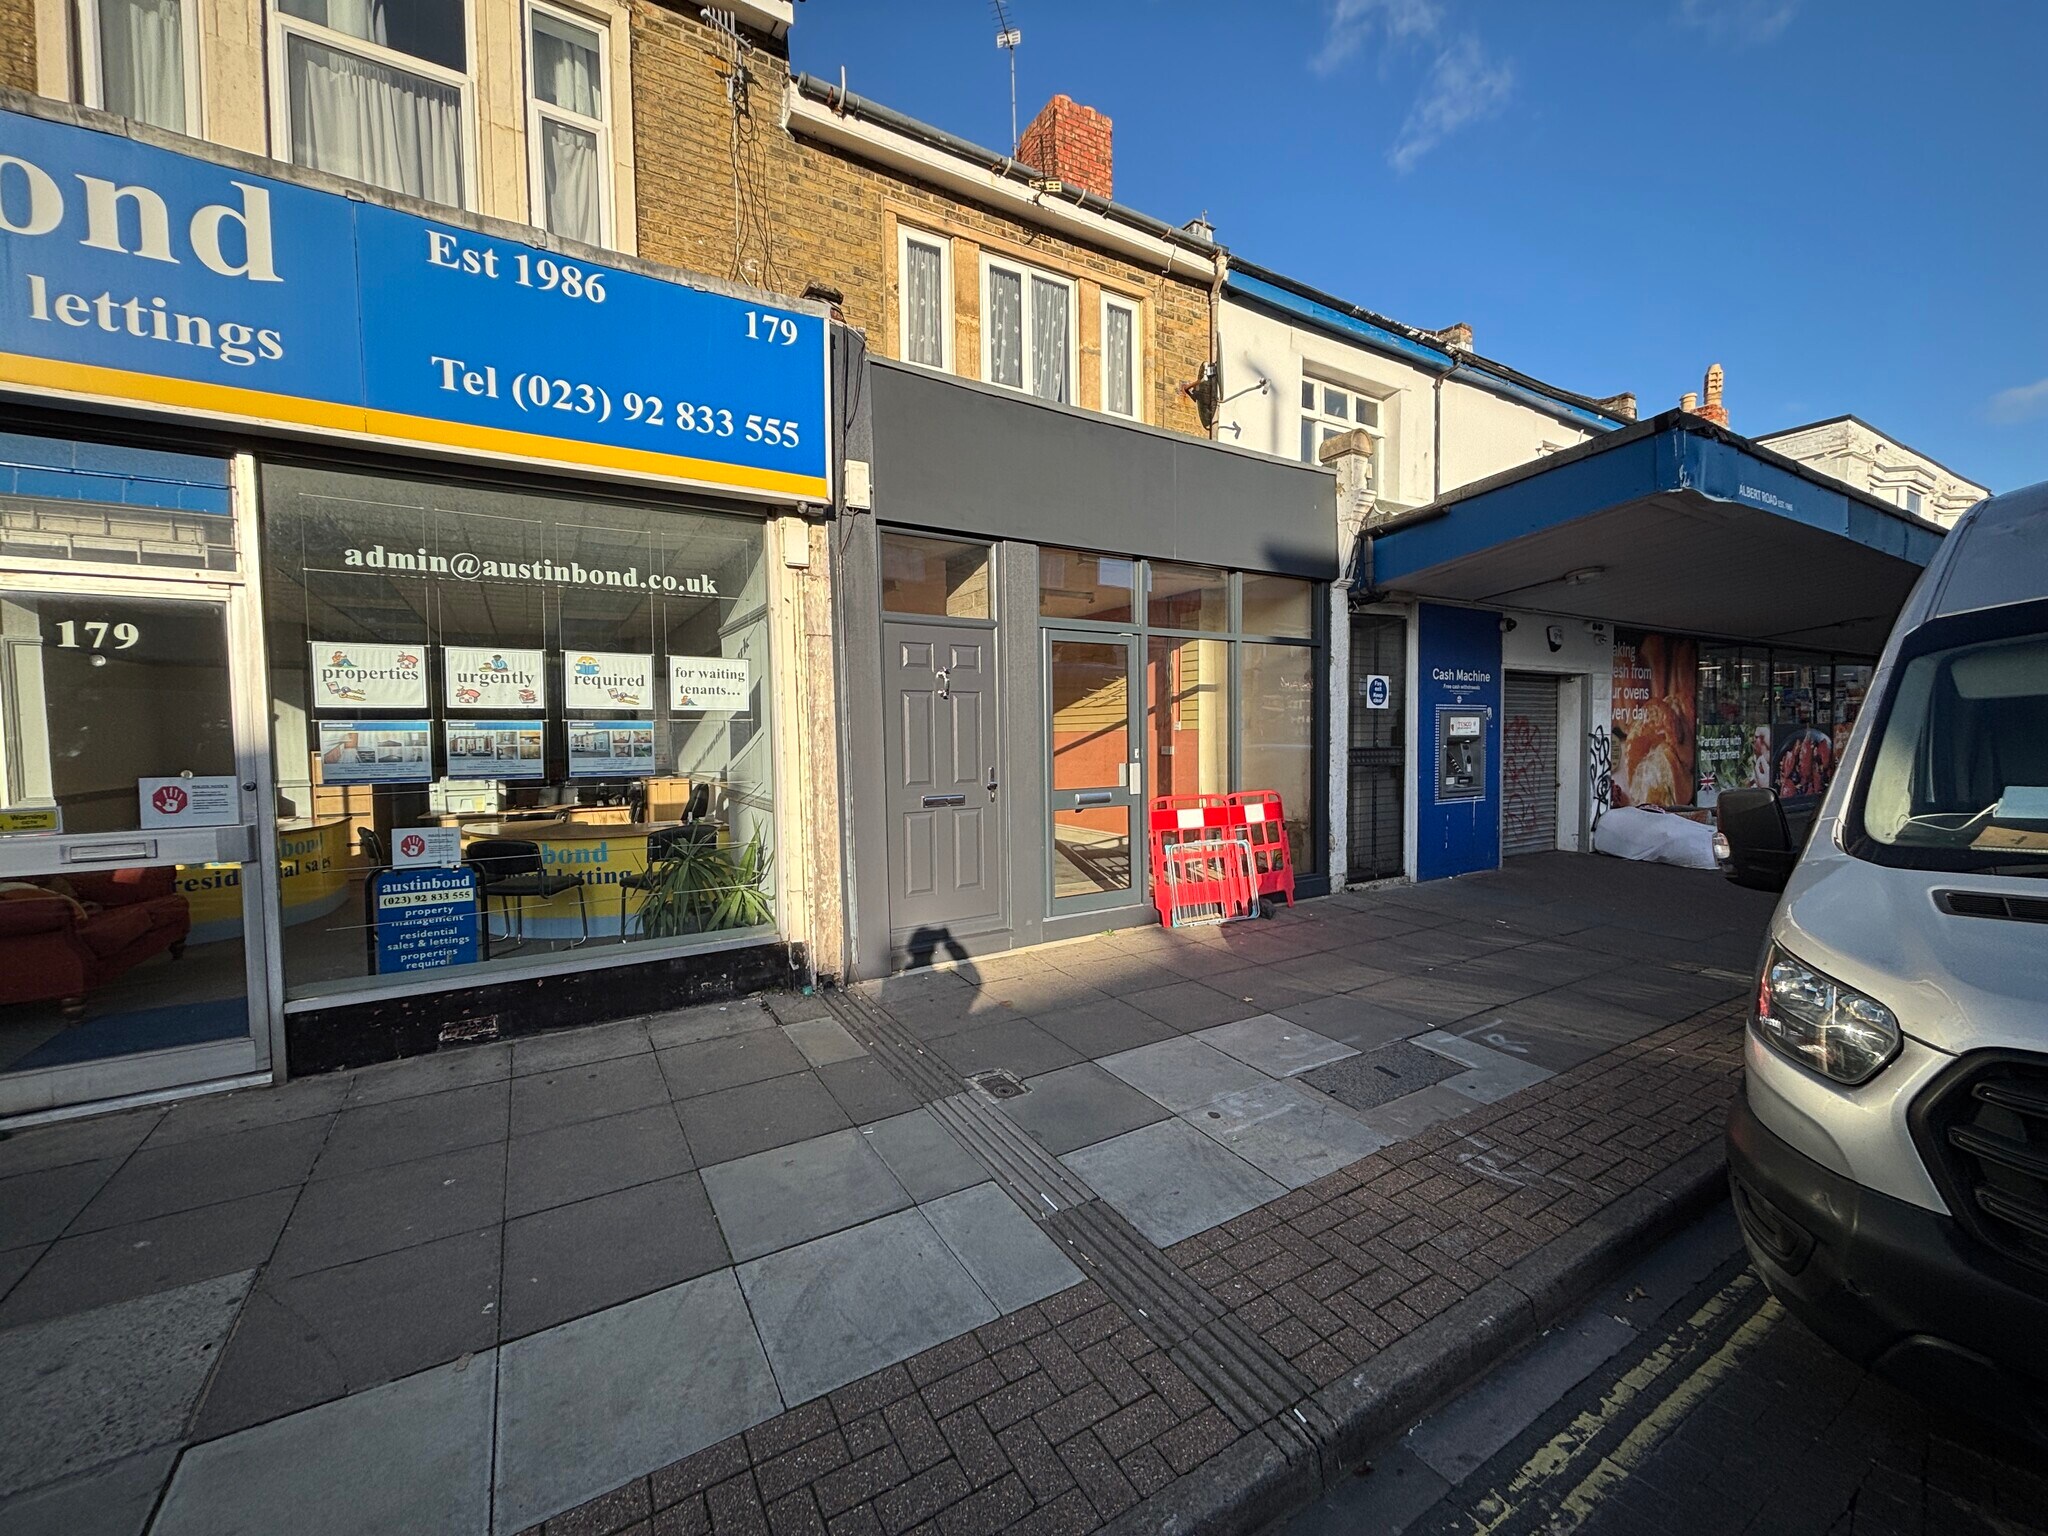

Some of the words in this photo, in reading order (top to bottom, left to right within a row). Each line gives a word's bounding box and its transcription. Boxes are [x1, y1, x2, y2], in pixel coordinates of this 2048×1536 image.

[425, 229, 499, 279] Est
[514, 254, 607, 304] 1986
[27, 274, 284, 366] lettings
[745, 310, 798, 346] 179
[431, 356, 499, 398] Tel
[513, 372, 611, 423] (023)
[624, 392, 664, 426] 92
[676, 401, 734, 437] 833
[745, 414, 799, 448] 555
[1739, 484, 1761, 501] ALBERT
[1762, 491, 1778, 506] ROAD
[344, 545, 718, 595] admin@austinbond.co.uk
[56, 620, 140, 650] 179
[321, 665, 419, 683] properties
[457, 670, 535, 688] urgently
[675, 667, 695, 679] for
[698, 668, 746, 683] waiting
[1432, 668, 1455, 681] Cash
[1456, 669, 1491, 682] Machine
[1613, 665, 1629, 679] esh
[1631, 664, 1652, 680] from
[574, 672, 645, 690] required
[680, 684, 741, 696] tenants...
[1624, 688, 1650, 700] ovens
[1700, 735, 1730, 748] Partnering
[1730, 735, 1742, 745] with
[1700, 749, 1719, 761] British
[1719, 749, 1741, 760] farmers
[382, 876, 470, 893] austinbond
[383, 896, 411, 906] (023)
[431, 893, 449, 901] 833
[453, 891, 471, 899] 555
[405, 906, 454, 918] property
[400, 927, 458, 940] residential
[387, 942, 415, 951] sales
[418, 939, 427, 947] &
[430, 936, 470, 946] lettings
[400, 948, 458, 962] properties
